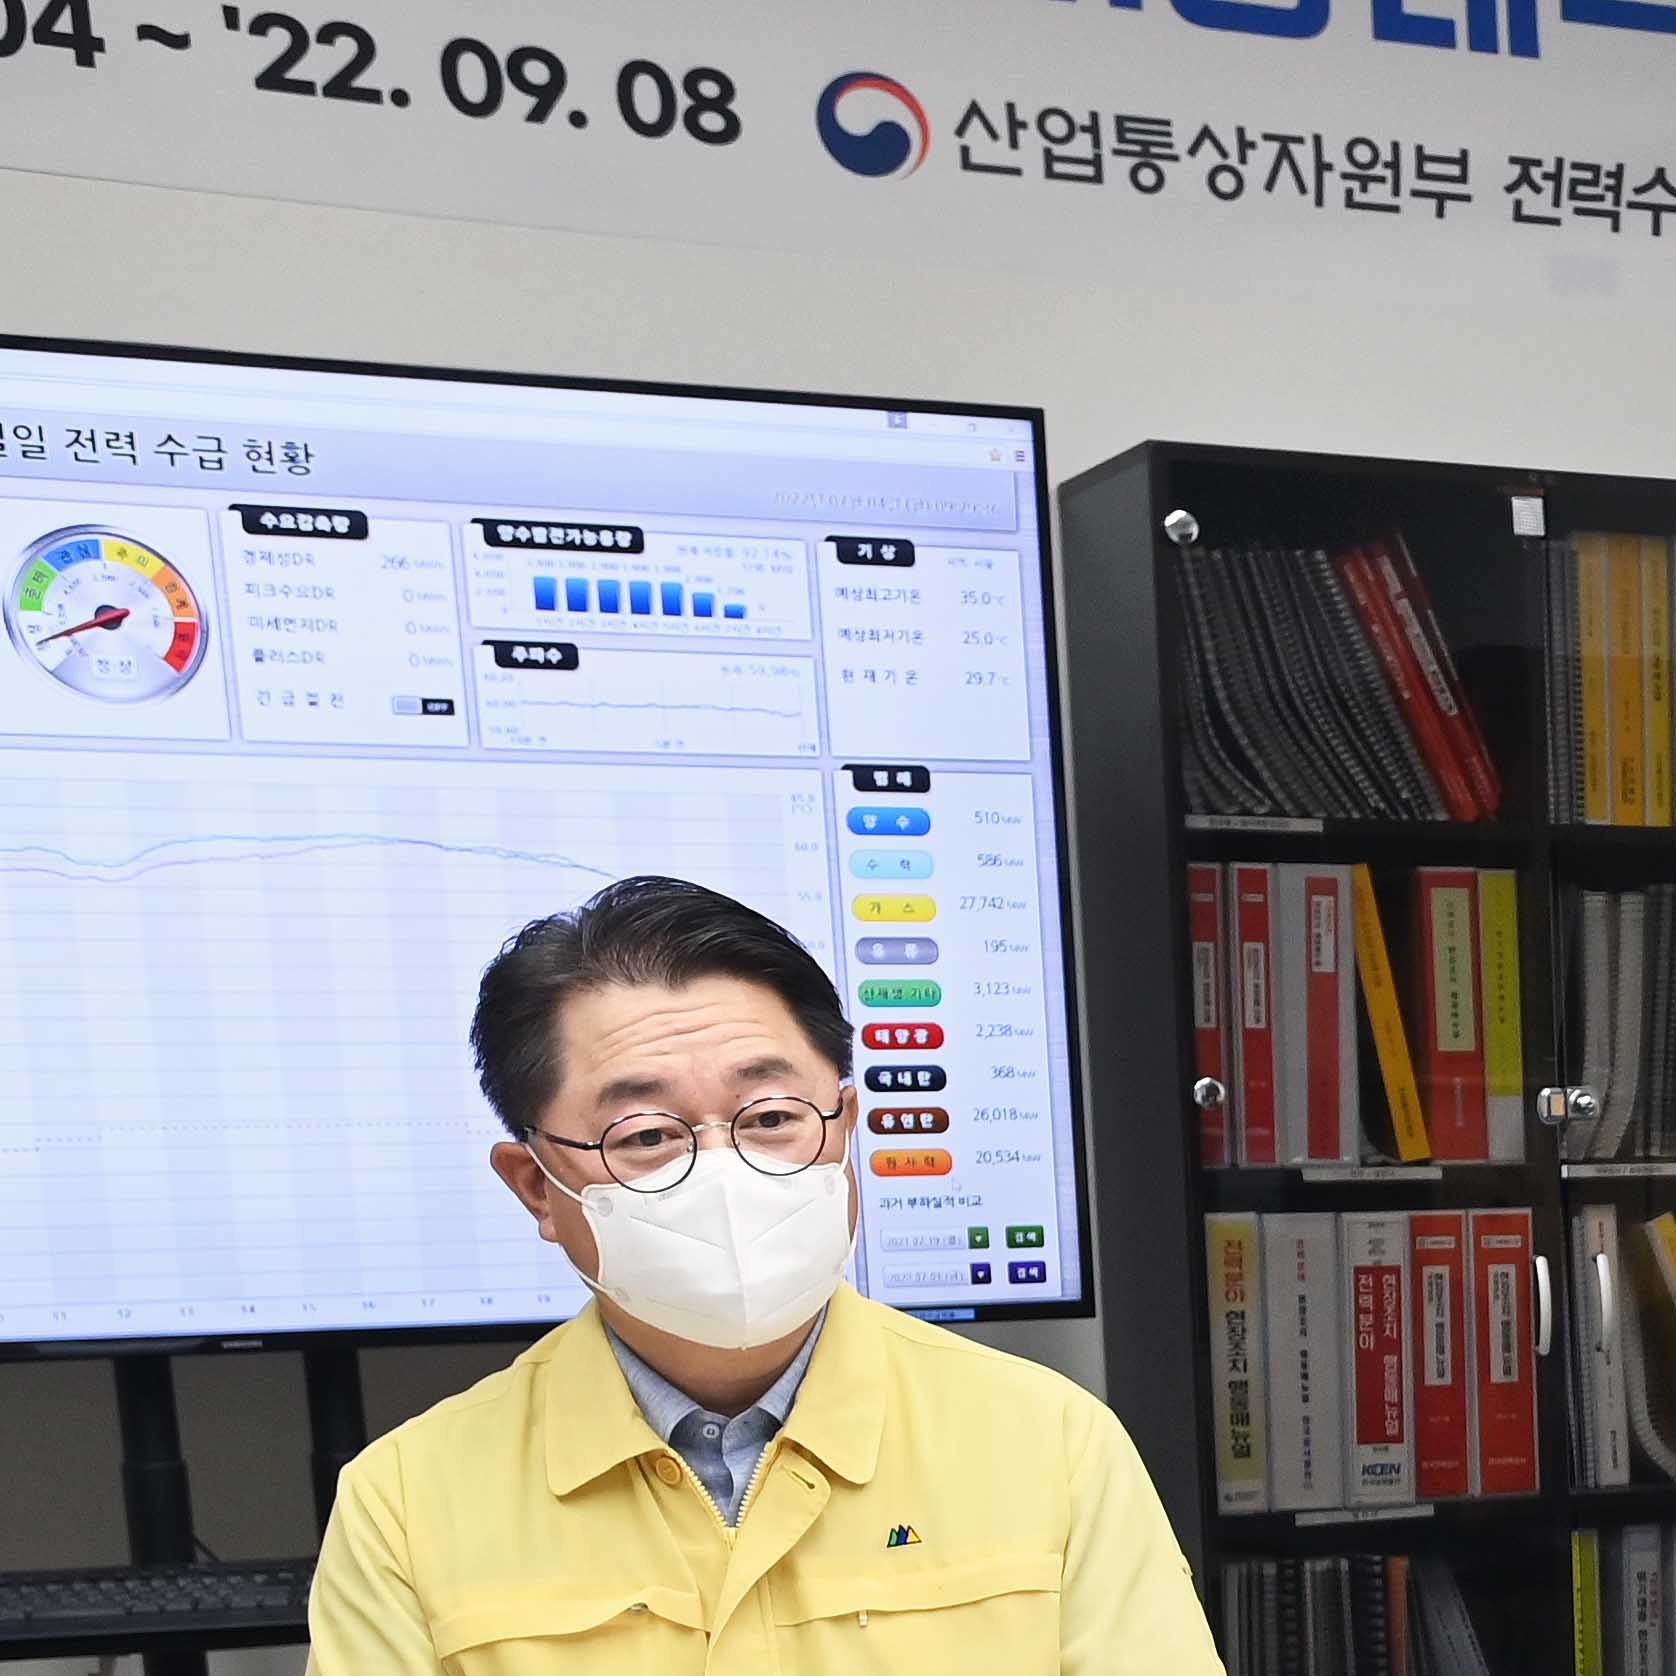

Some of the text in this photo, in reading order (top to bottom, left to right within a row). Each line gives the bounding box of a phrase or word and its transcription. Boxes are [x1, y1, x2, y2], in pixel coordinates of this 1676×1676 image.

[440, 36, 589, 131] 09.
[616, 59, 743, 147] 08
[953, 97, 1474, 221] 산업통상자원부
[0, 423, 315, 477] 일 전력 수급 현황
